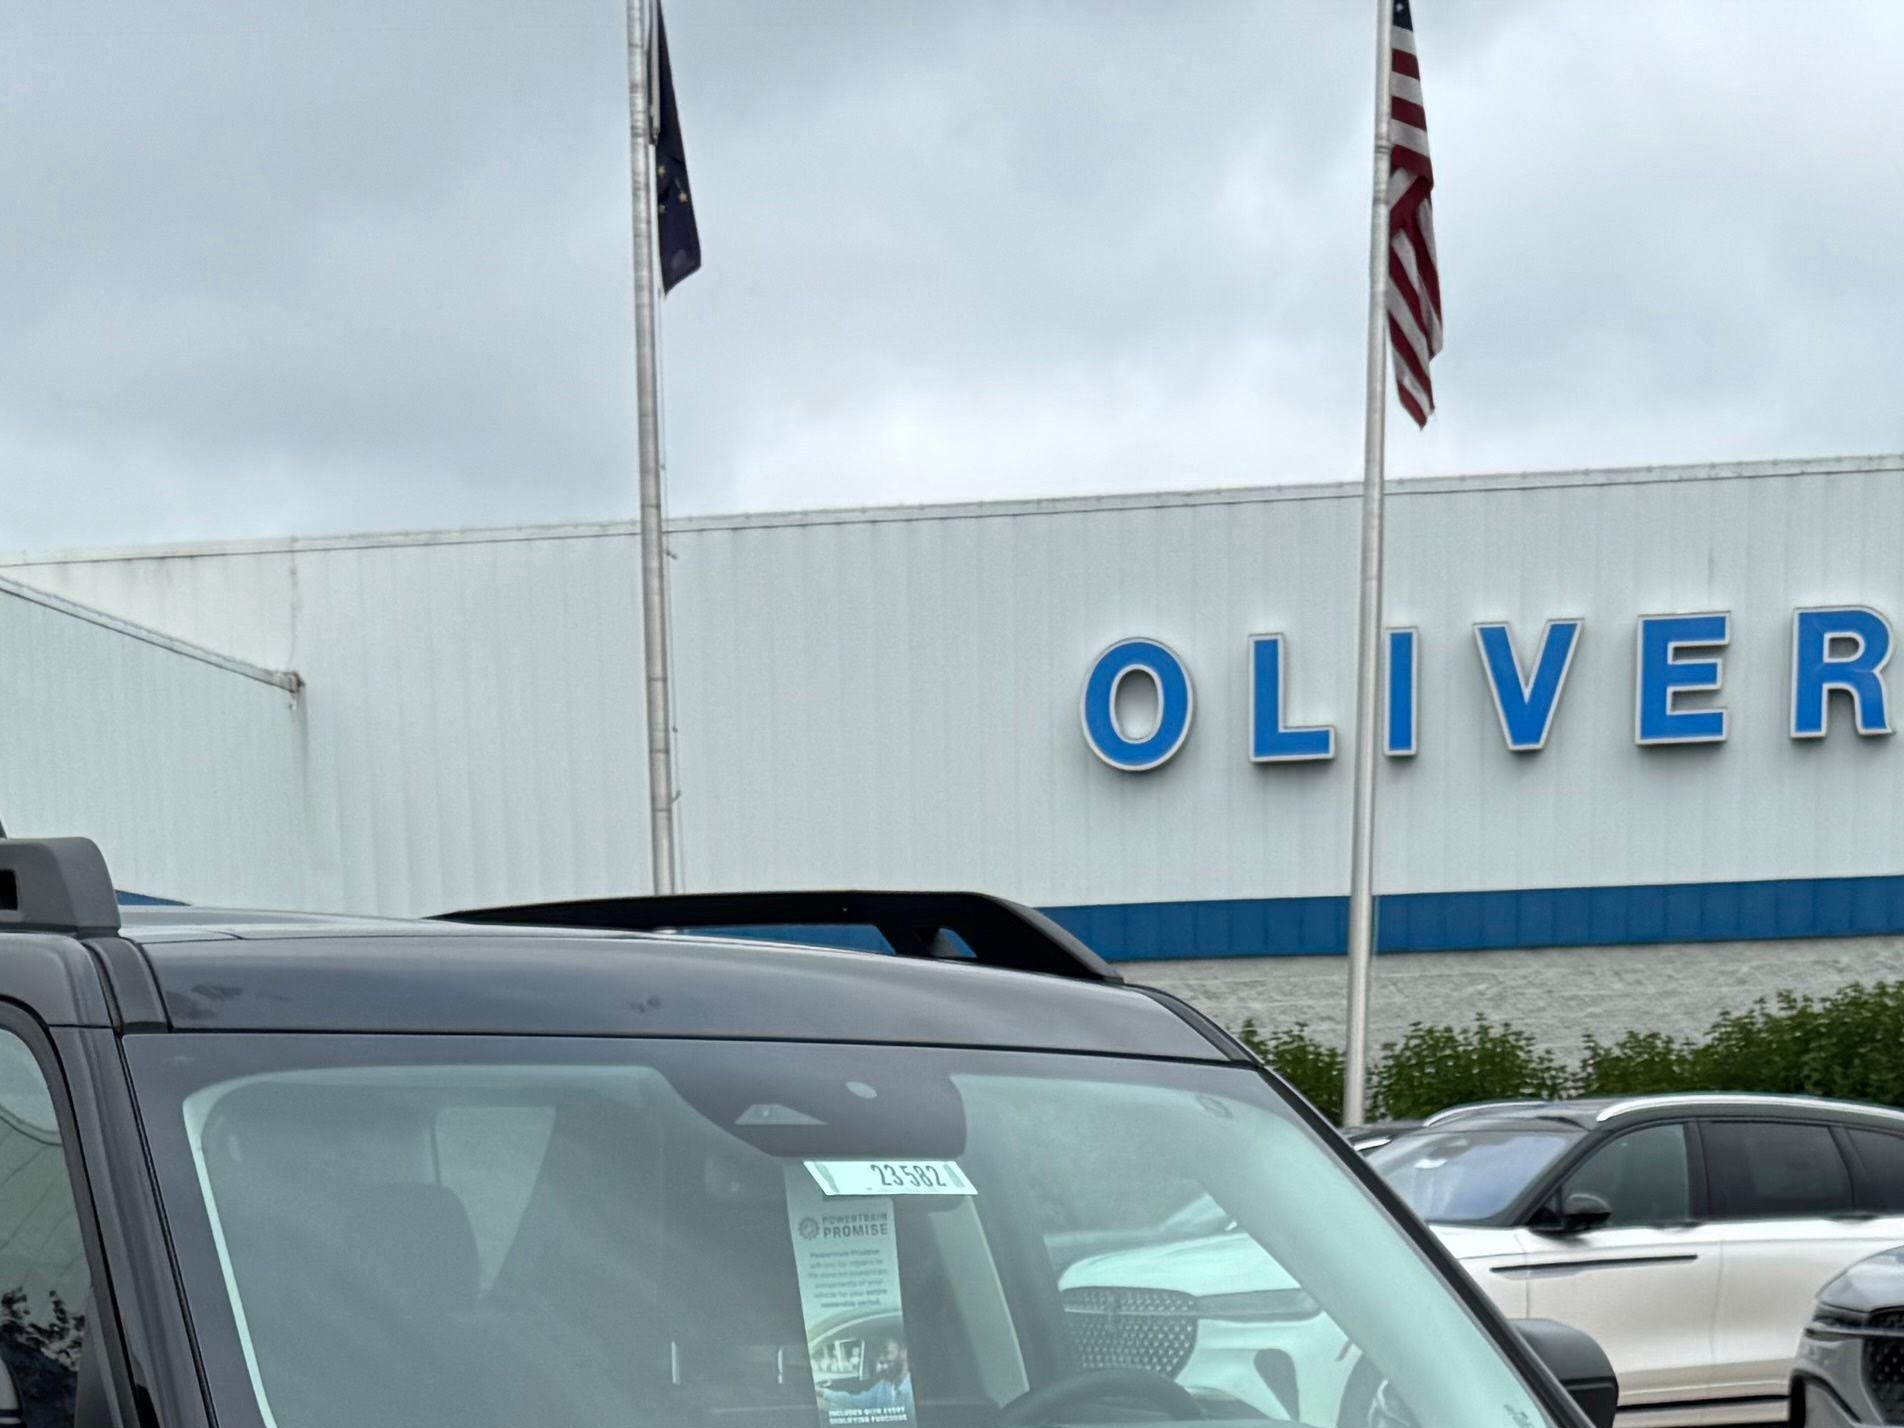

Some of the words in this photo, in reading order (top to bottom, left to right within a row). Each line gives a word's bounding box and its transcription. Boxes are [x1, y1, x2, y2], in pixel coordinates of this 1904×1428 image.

[1079, 603, 1896, 773] OLIVER
[871, 1164, 947, 1187] 23582
[823, 1223, 888, 1238] PROMISE
